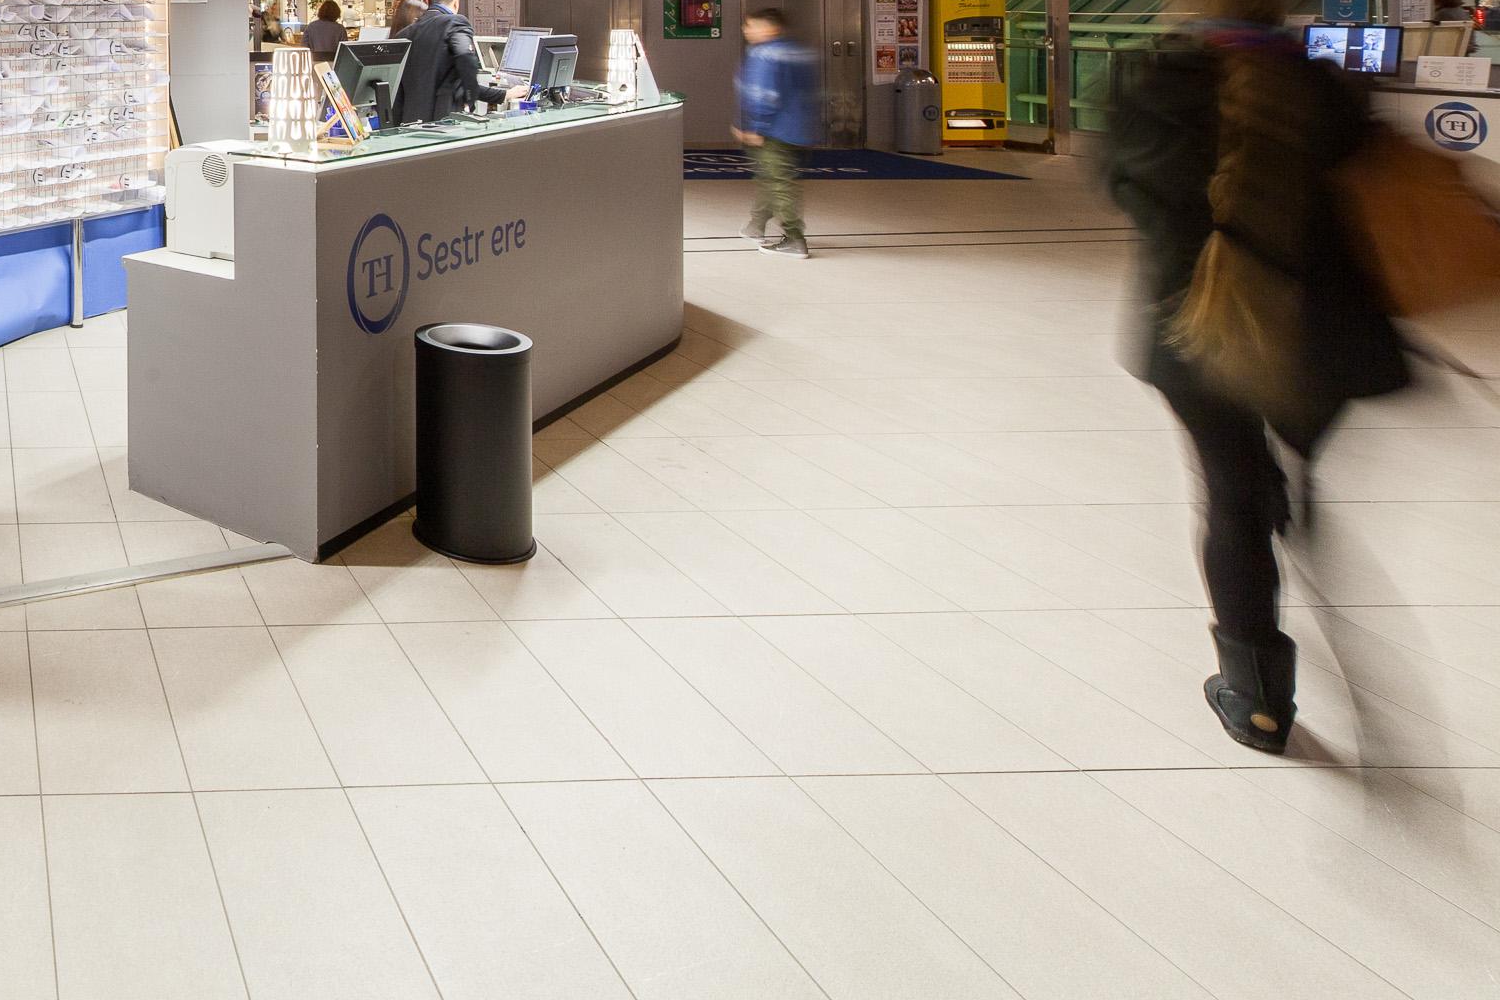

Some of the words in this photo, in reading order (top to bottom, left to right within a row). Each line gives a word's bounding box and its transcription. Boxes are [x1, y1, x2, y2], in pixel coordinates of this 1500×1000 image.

[1446, 120, 1468, 132] TH
[416, 225, 485, 281] Sestr
[490, 218, 526, 257] ere
[362, 254, 394, 298] TH
